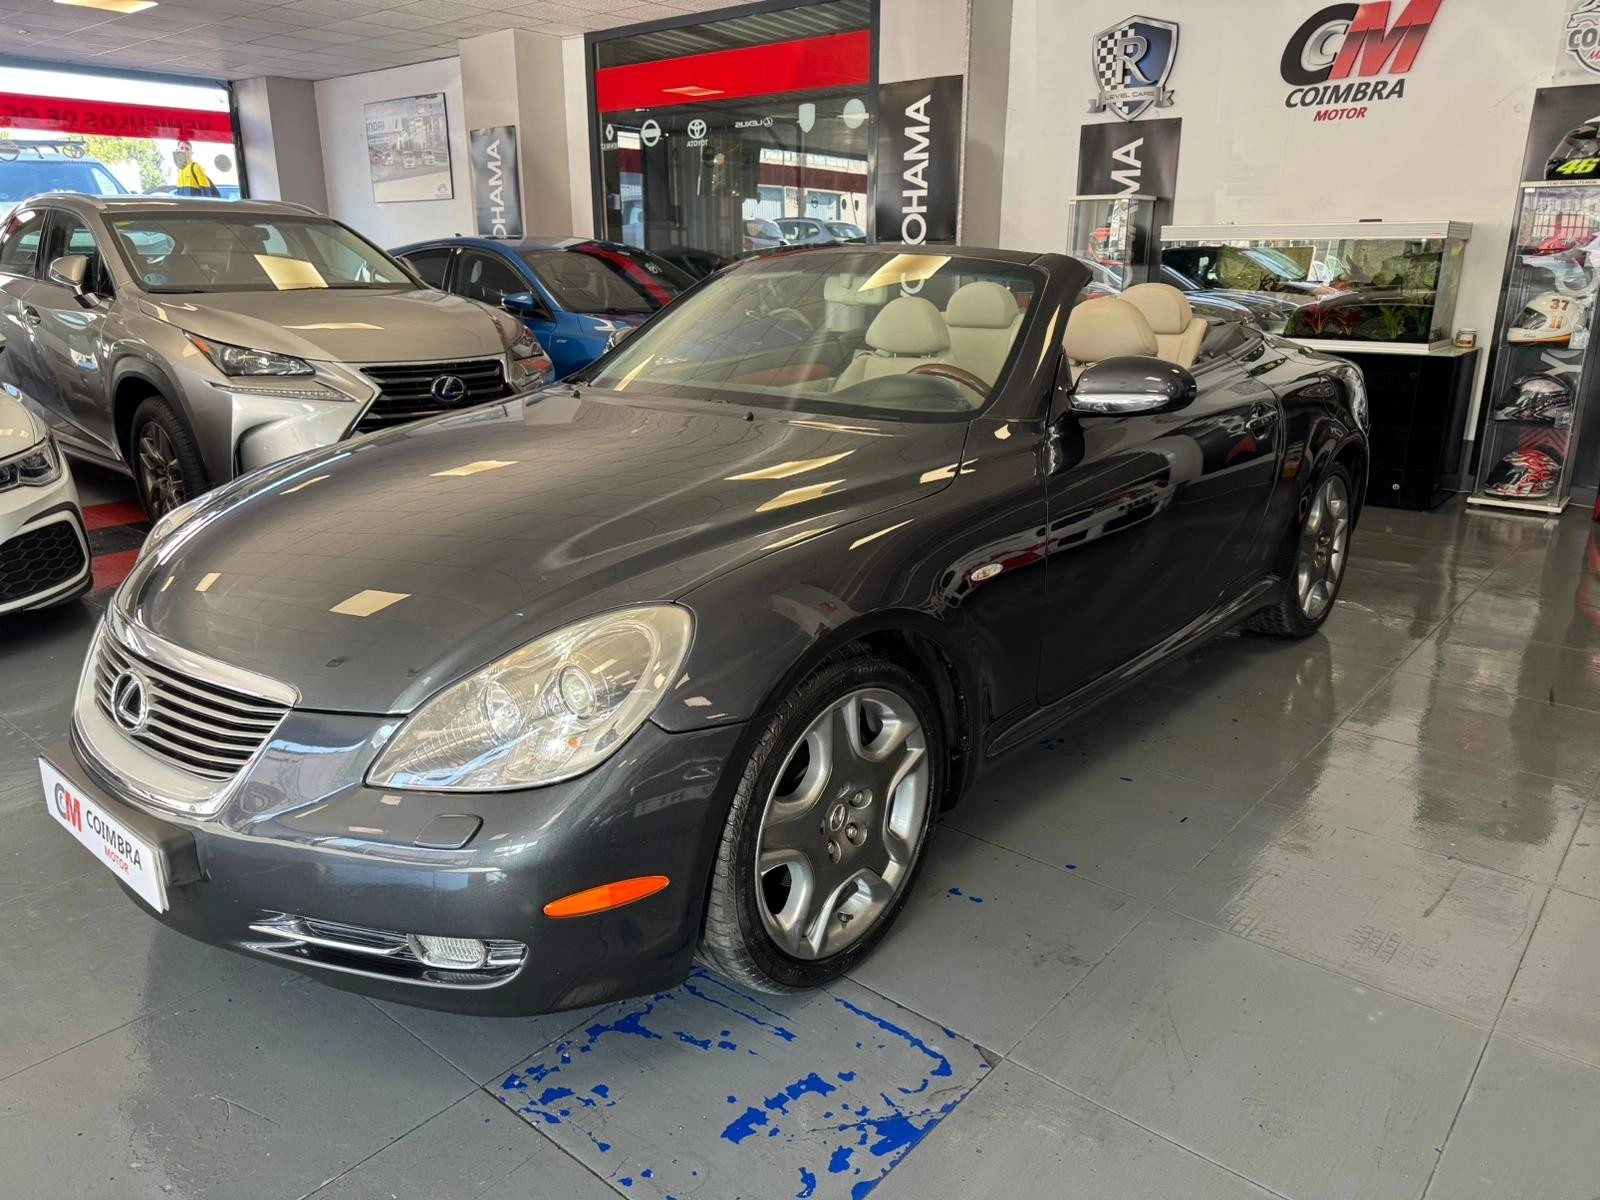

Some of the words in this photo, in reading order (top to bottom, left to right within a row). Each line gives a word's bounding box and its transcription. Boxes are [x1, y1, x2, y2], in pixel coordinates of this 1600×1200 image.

[1568, 27, 1600, 49] CO
[1285, 78, 1405, 108] COIMBRA
[1313, 107, 1367, 122] MOTOR
[1551, 299, 1570, 311] 37
[86, 809, 142, 871] COIMBRA
[104, 846, 129, 873] MOTOR
